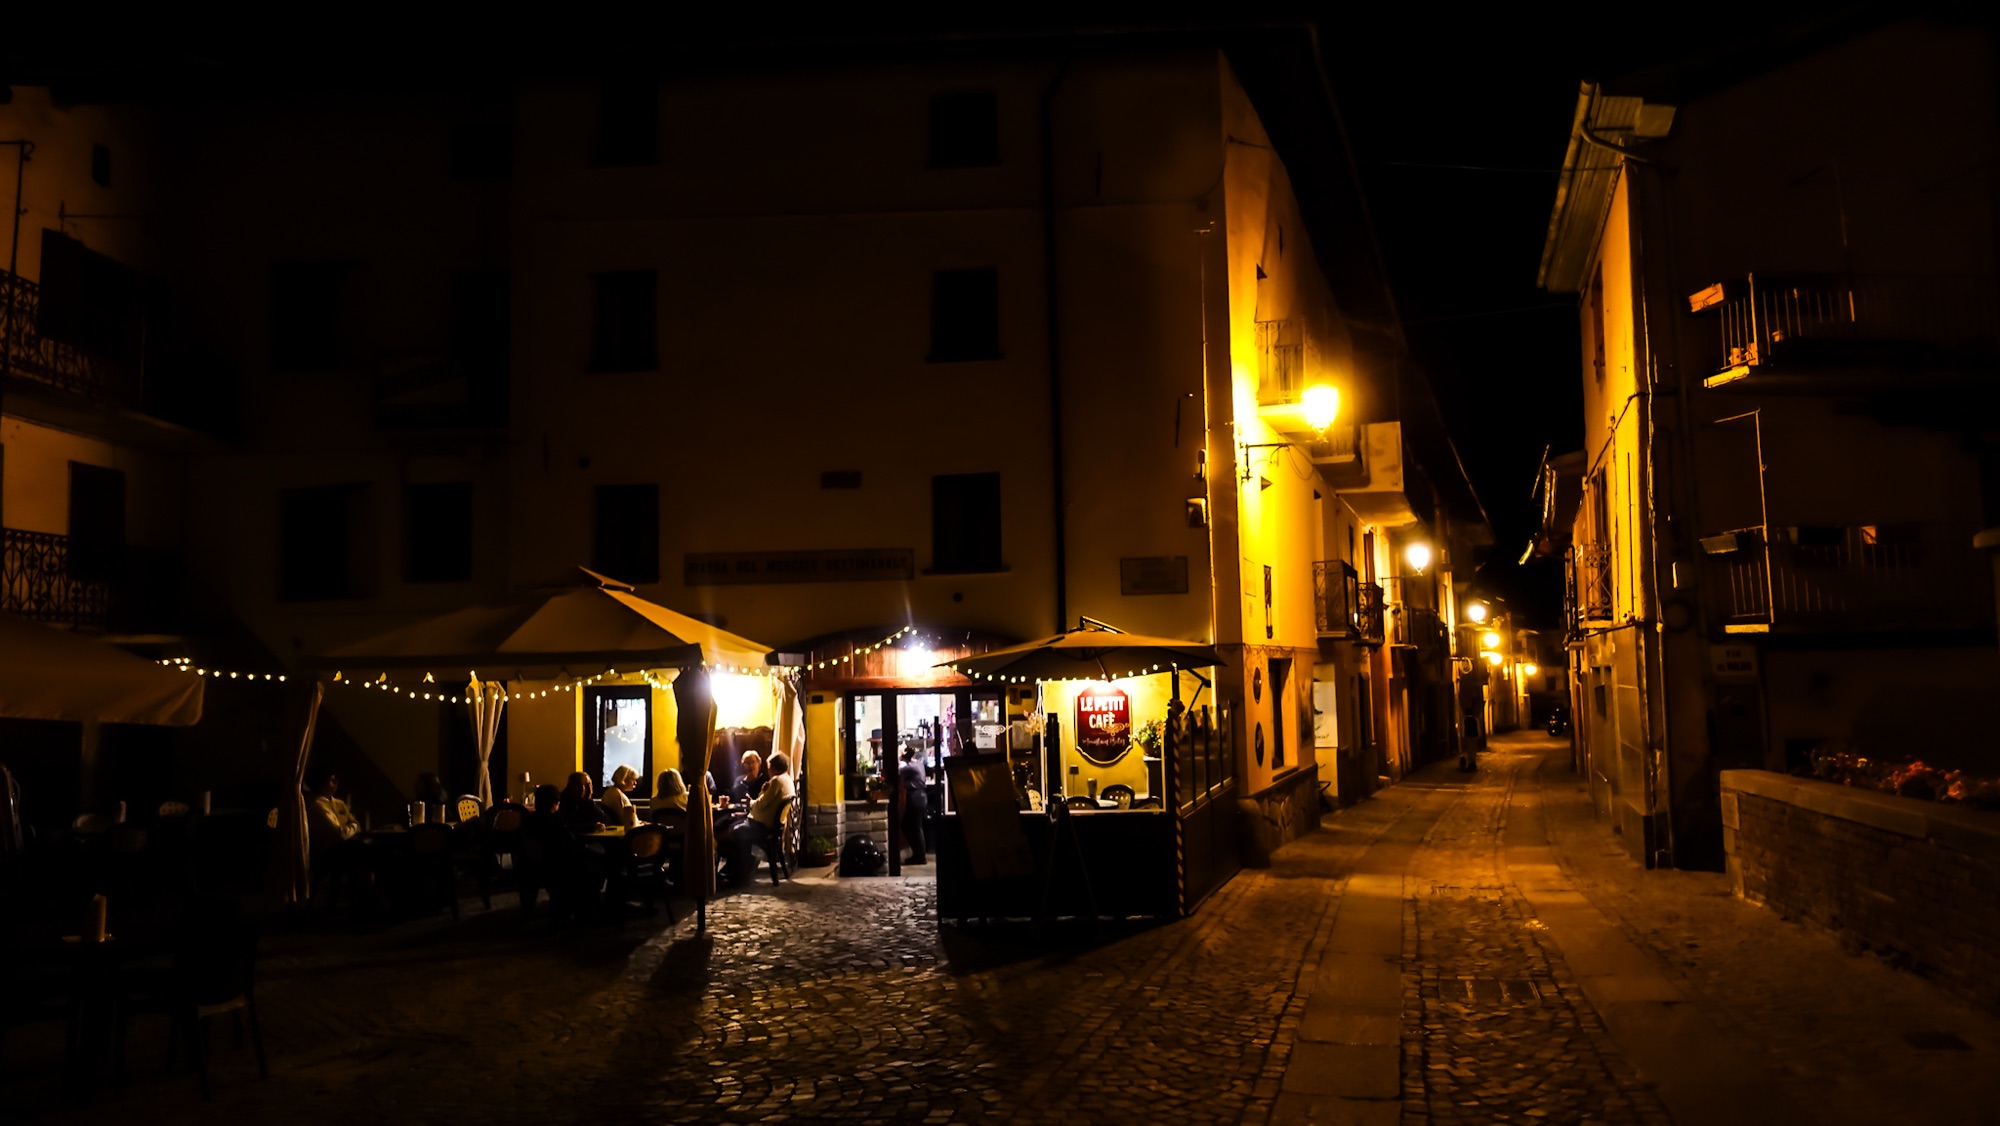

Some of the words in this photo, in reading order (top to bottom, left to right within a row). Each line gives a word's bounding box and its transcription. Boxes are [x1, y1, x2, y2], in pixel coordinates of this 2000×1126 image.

[687, 560, 728, 575] PIAZZA
[735, 559, 758, 574] DEL
[766, 558, 818, 573] MERCATO
[1726, 650, 1741, 658] VIA
[1080, 696, 1093, 711] LE
[1094, 696, 1125, 712] PETIT
